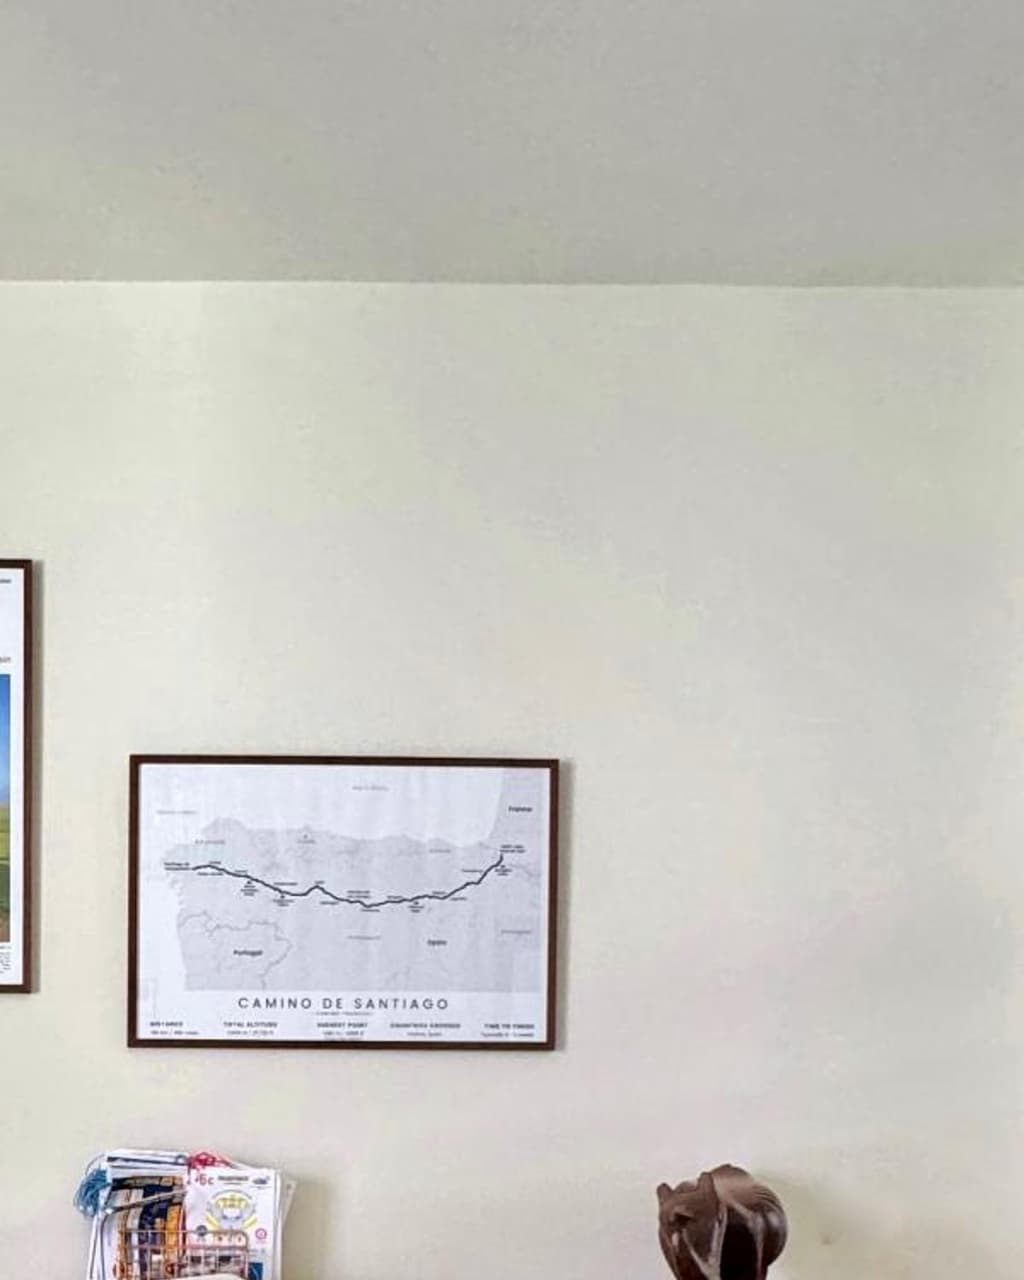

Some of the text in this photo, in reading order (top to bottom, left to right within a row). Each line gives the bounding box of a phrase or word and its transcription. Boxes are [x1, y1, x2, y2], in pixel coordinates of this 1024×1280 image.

[237, 997, 449, 1011] CAMINO DE SANTIAGO
